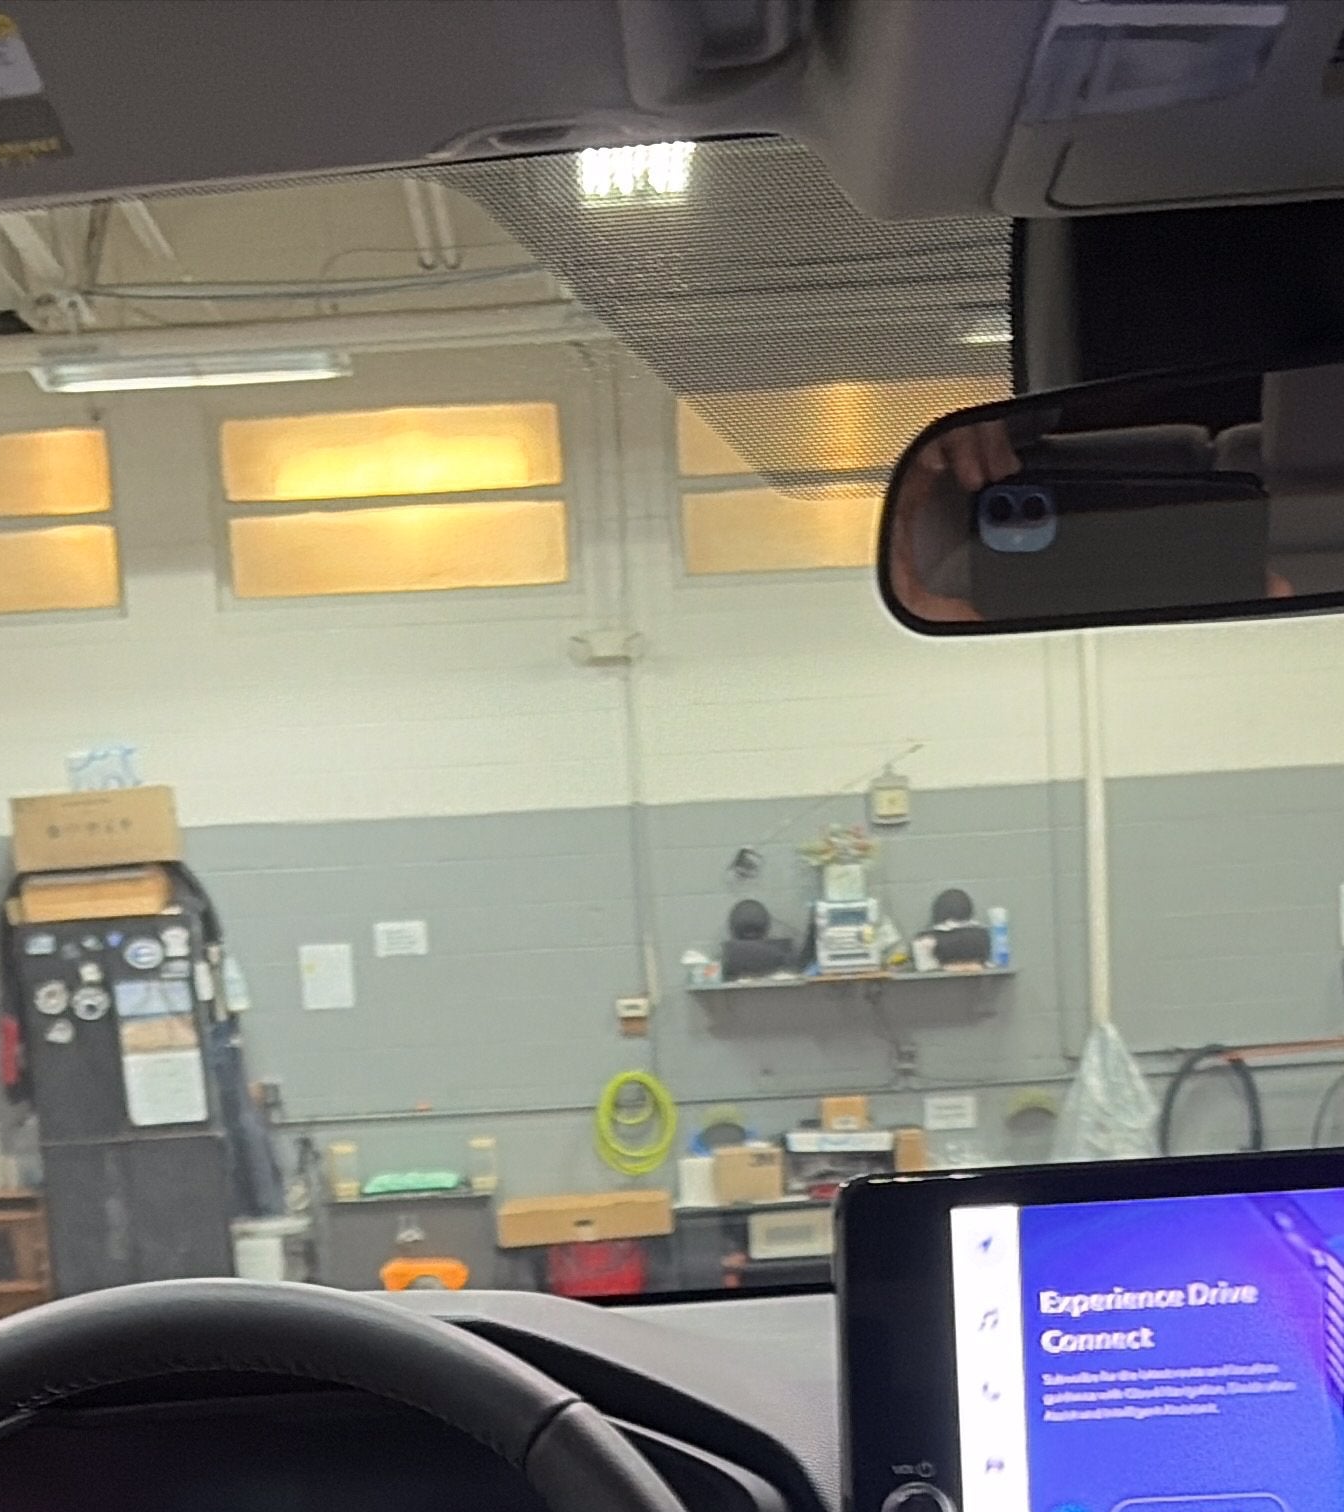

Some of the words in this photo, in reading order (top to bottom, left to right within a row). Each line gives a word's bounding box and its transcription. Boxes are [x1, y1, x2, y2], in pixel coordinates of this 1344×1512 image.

[1039, 1287, 1186, 1317] Experience
[1186, 1281, 1259, 1306] Drive
[1040, 1326, 1155, 1353] Connect
